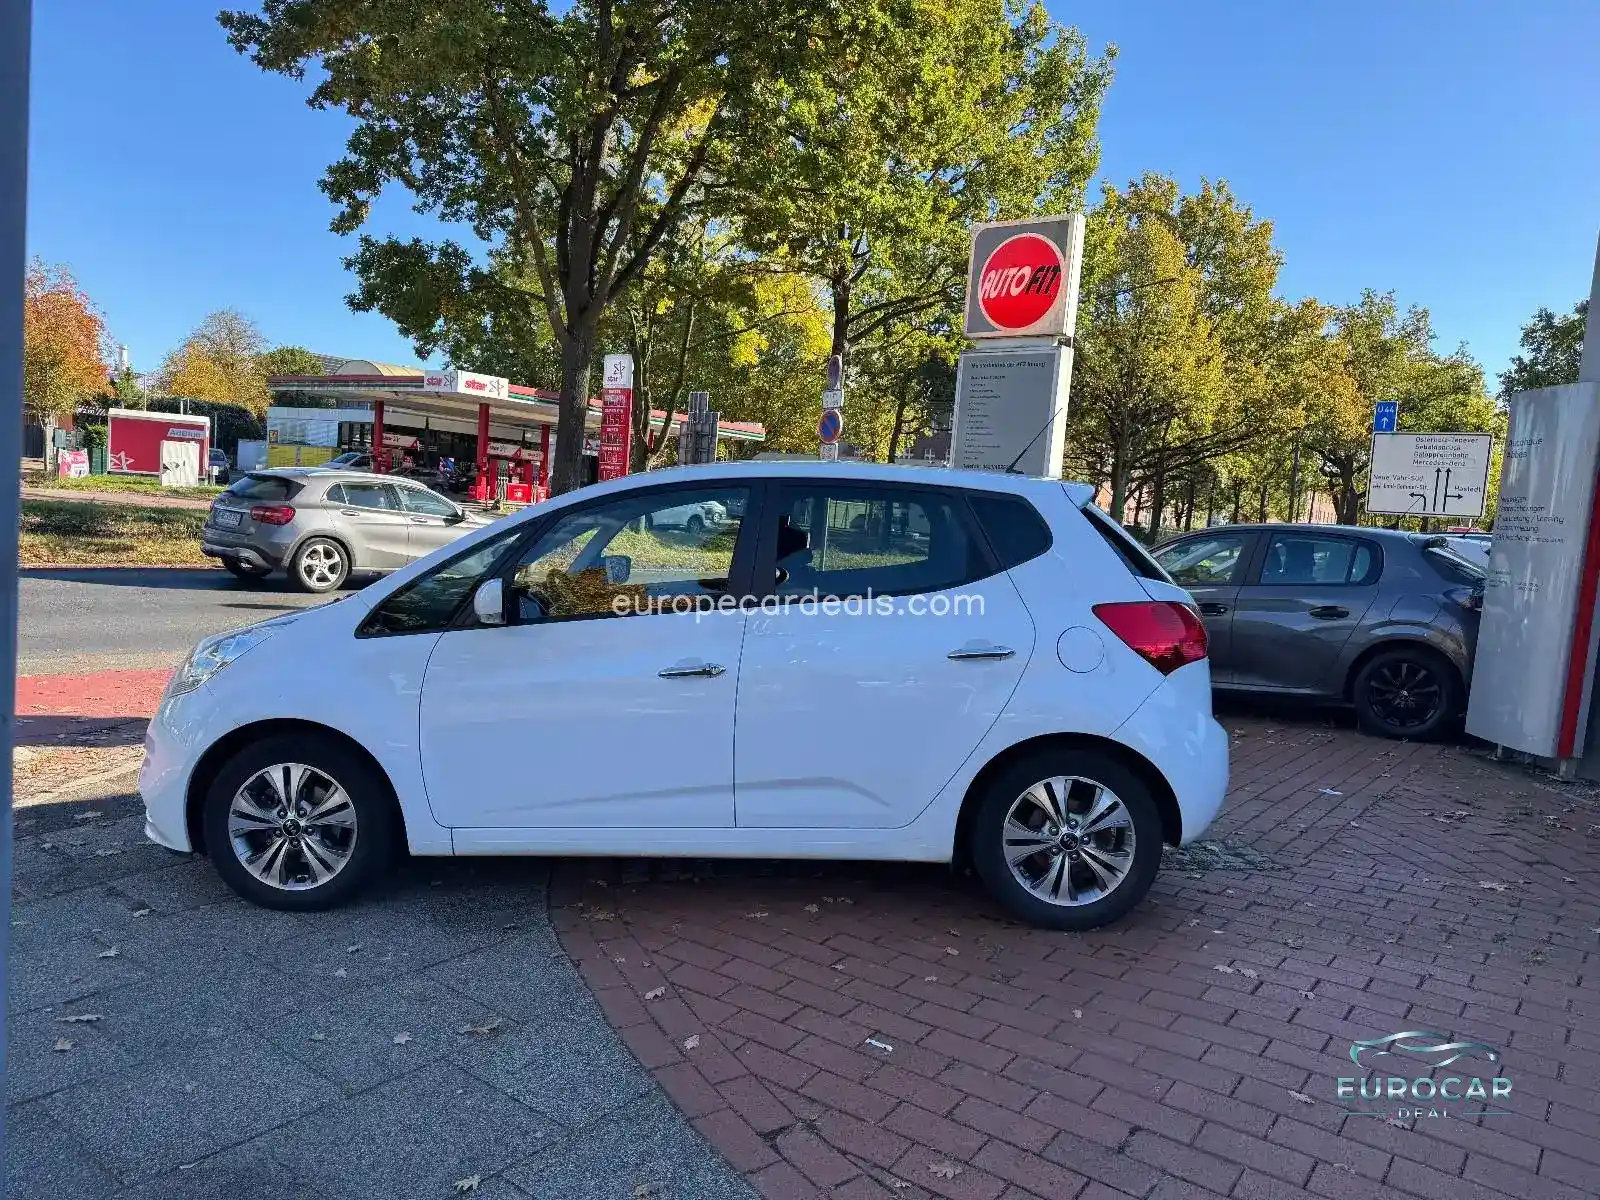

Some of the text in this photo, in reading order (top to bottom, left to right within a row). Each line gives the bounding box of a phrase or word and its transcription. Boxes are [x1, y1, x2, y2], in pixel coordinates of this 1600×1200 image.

[981, 264, 1061, 299] AUTOFIT
[426, 376, 443, 386] star
[465, 378, 487, 391] star
